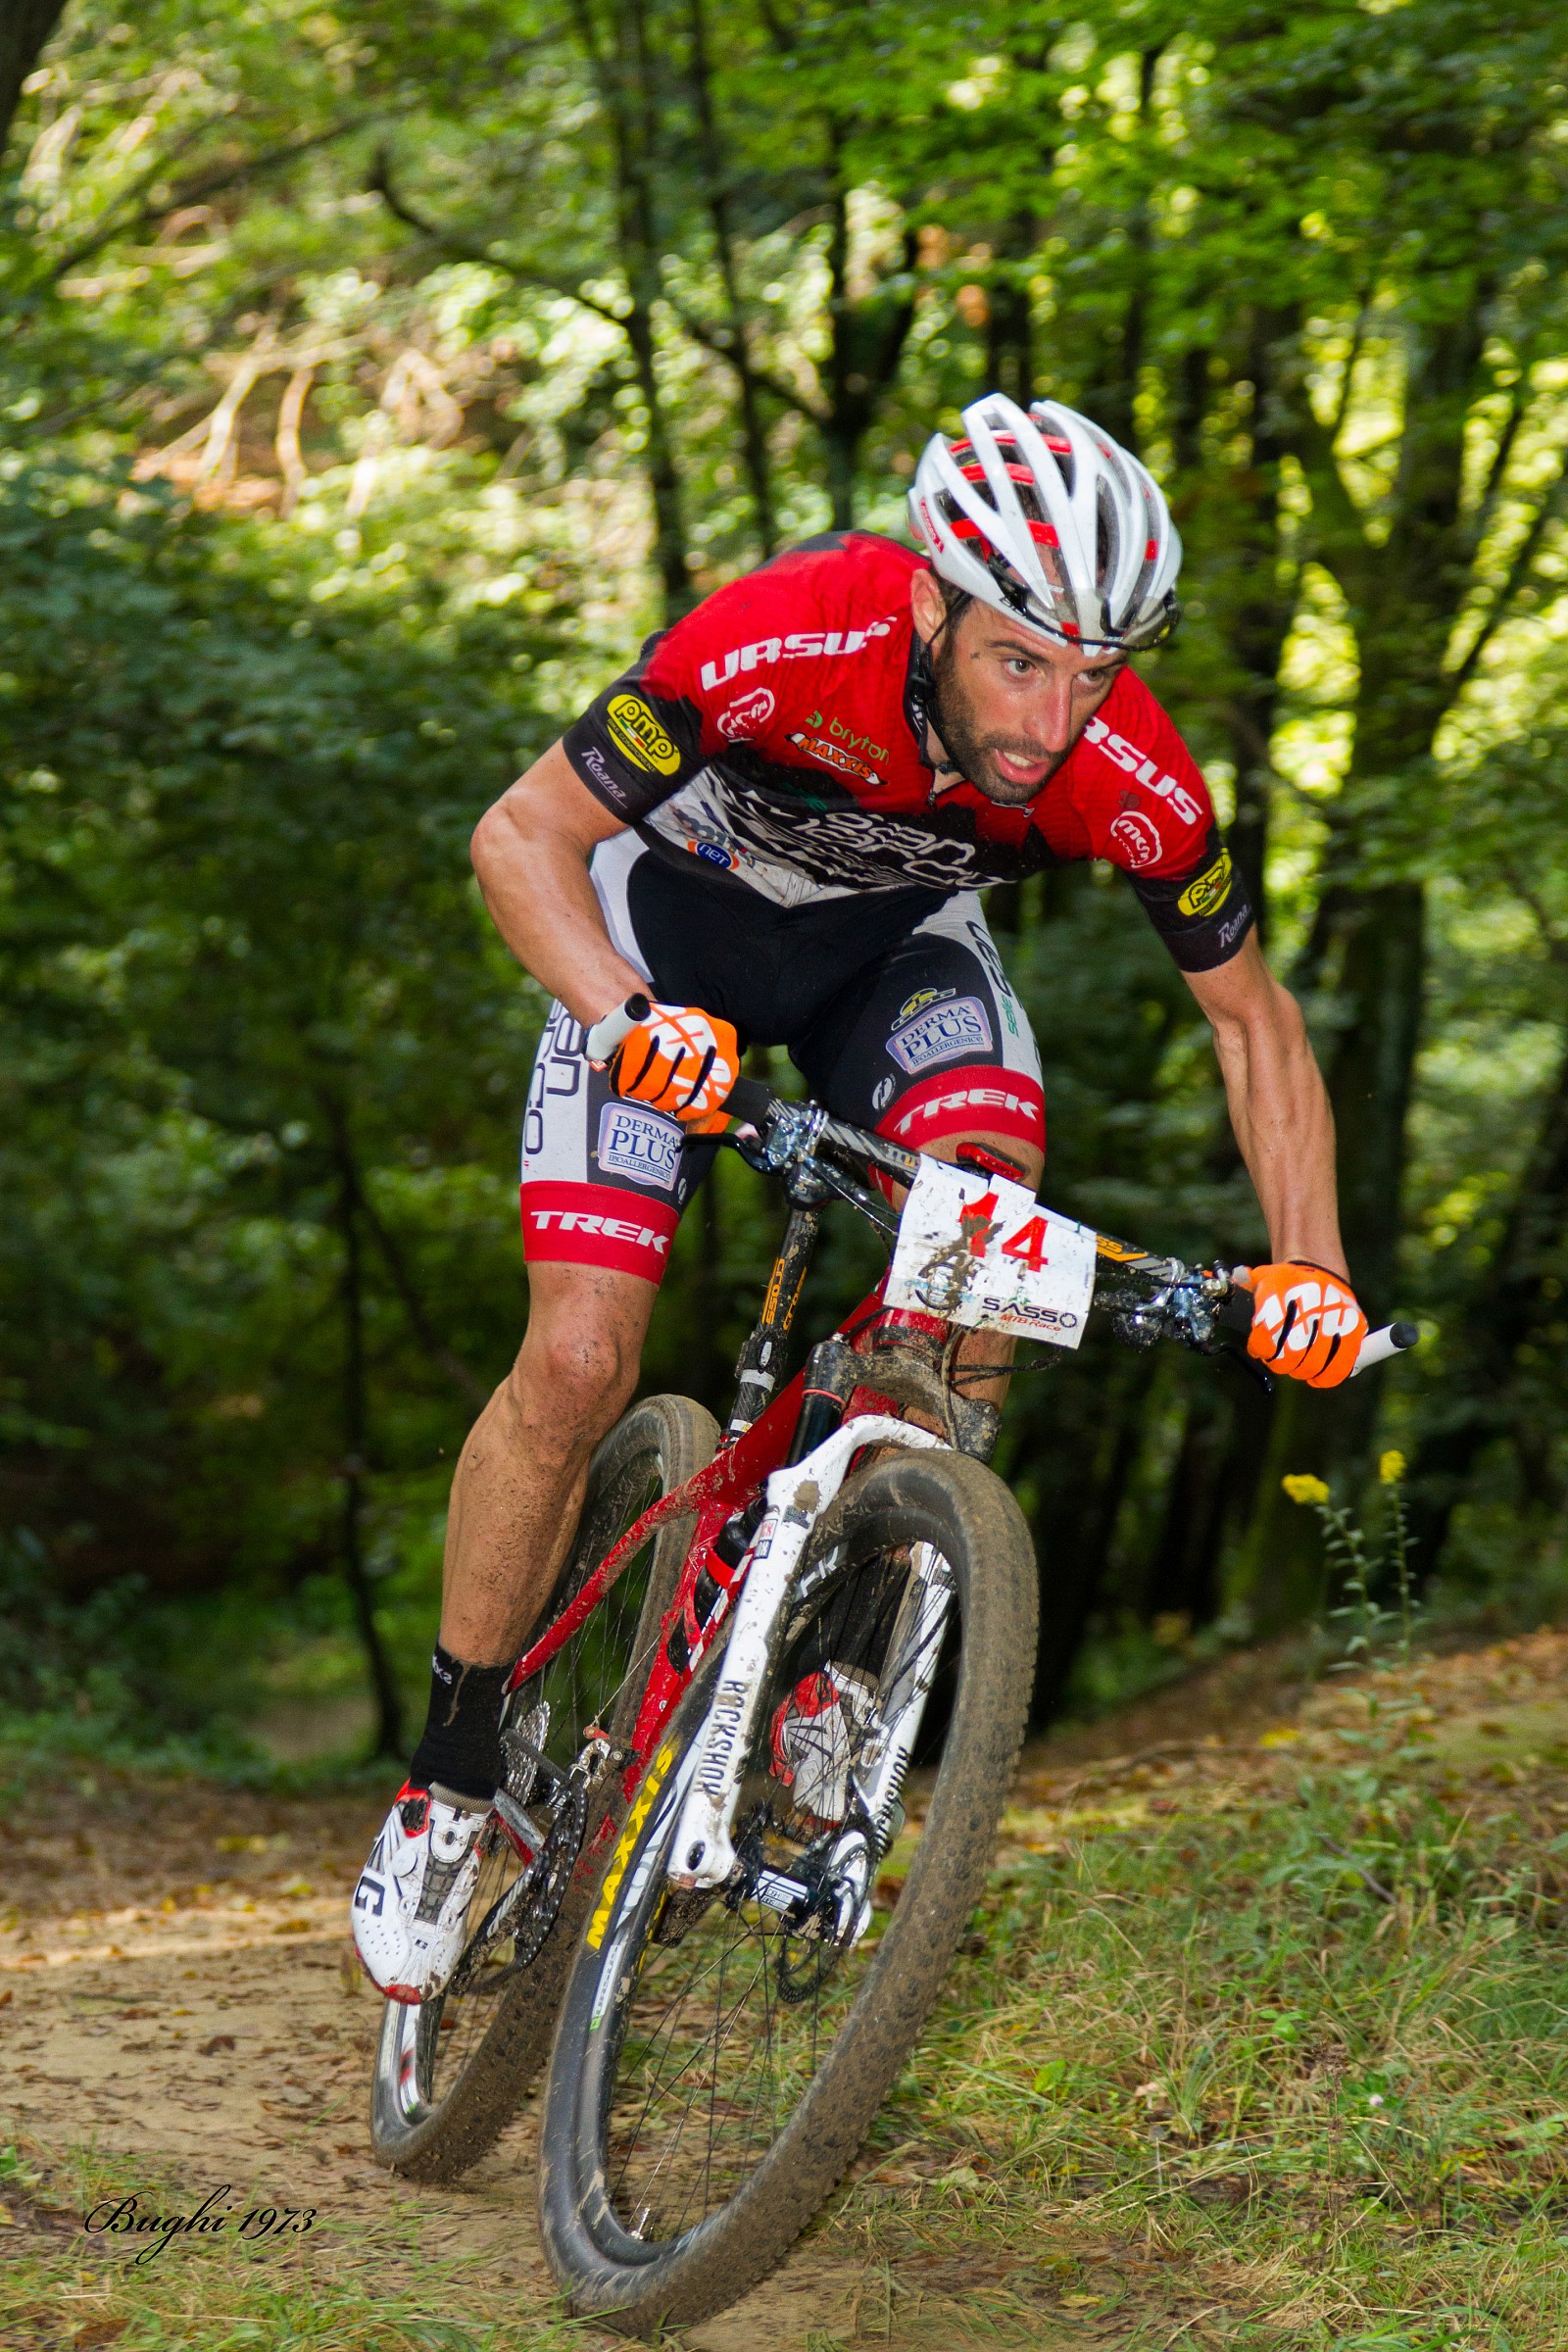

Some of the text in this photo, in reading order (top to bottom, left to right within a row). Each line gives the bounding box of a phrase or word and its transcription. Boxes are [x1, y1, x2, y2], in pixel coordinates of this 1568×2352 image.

[797, 737, 873, 780] MAXXIS
[1083, 715, 1203, 825] RSUS
[900, 1006, 971, 1047] DERMA
[903, 1014, 983, 1059] PLUS
[616, 1113, 676, 1149] DERMA
[893, 1088, 1040, 1135] TREK
[608, 1128, 677, 1170] PLUS
[530, 1209, 670, 1254] TREK
[958, 1191, 1050, 1273] 14
[982, 1297, 1078, 1329] SASSO
[587, 1742, 675, 1950] MAXXIS
